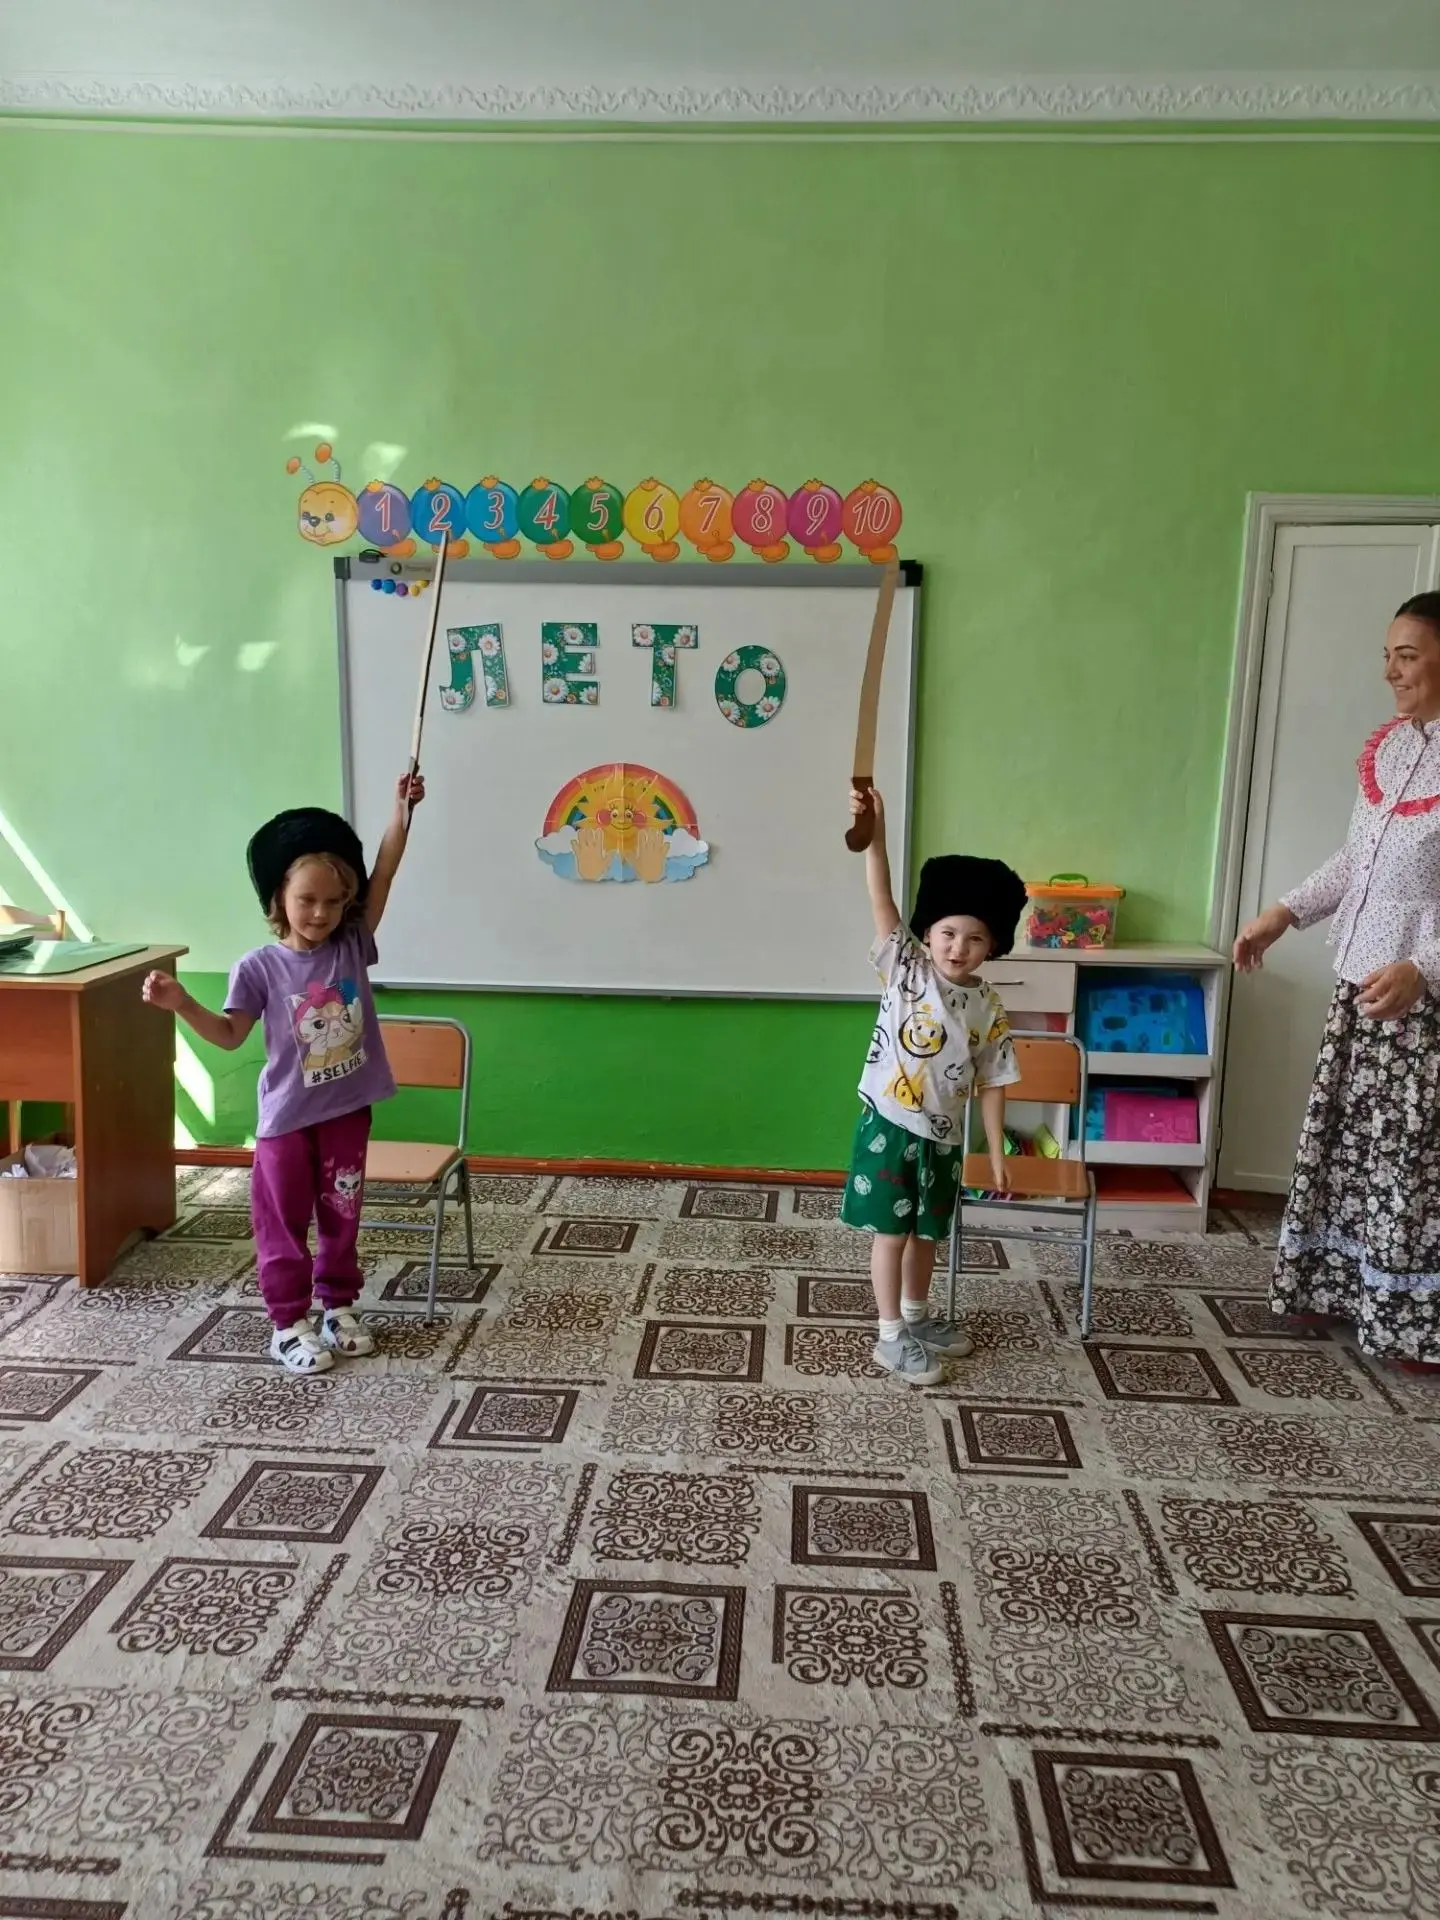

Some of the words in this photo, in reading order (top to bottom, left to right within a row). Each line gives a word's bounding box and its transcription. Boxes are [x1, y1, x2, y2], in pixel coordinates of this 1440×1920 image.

[375, 492, 391, 532] 1
[429, 493, 451, 532] 2
[484, 492, 505, 530] 3
[533, 491, 559, 529] 4
[588, 493, 610, 531] 5
[644, 493, 666, 532] 6
[698, 496, 721, 534] 7
[752, 494, 775, 534] 8
[806, 494, 830, 536] 9
[852, 495, 892, 535] 10
[439, 622, 786, 729] ЛЕТО
[311, 1051, 362, 1083] #SELFIE
